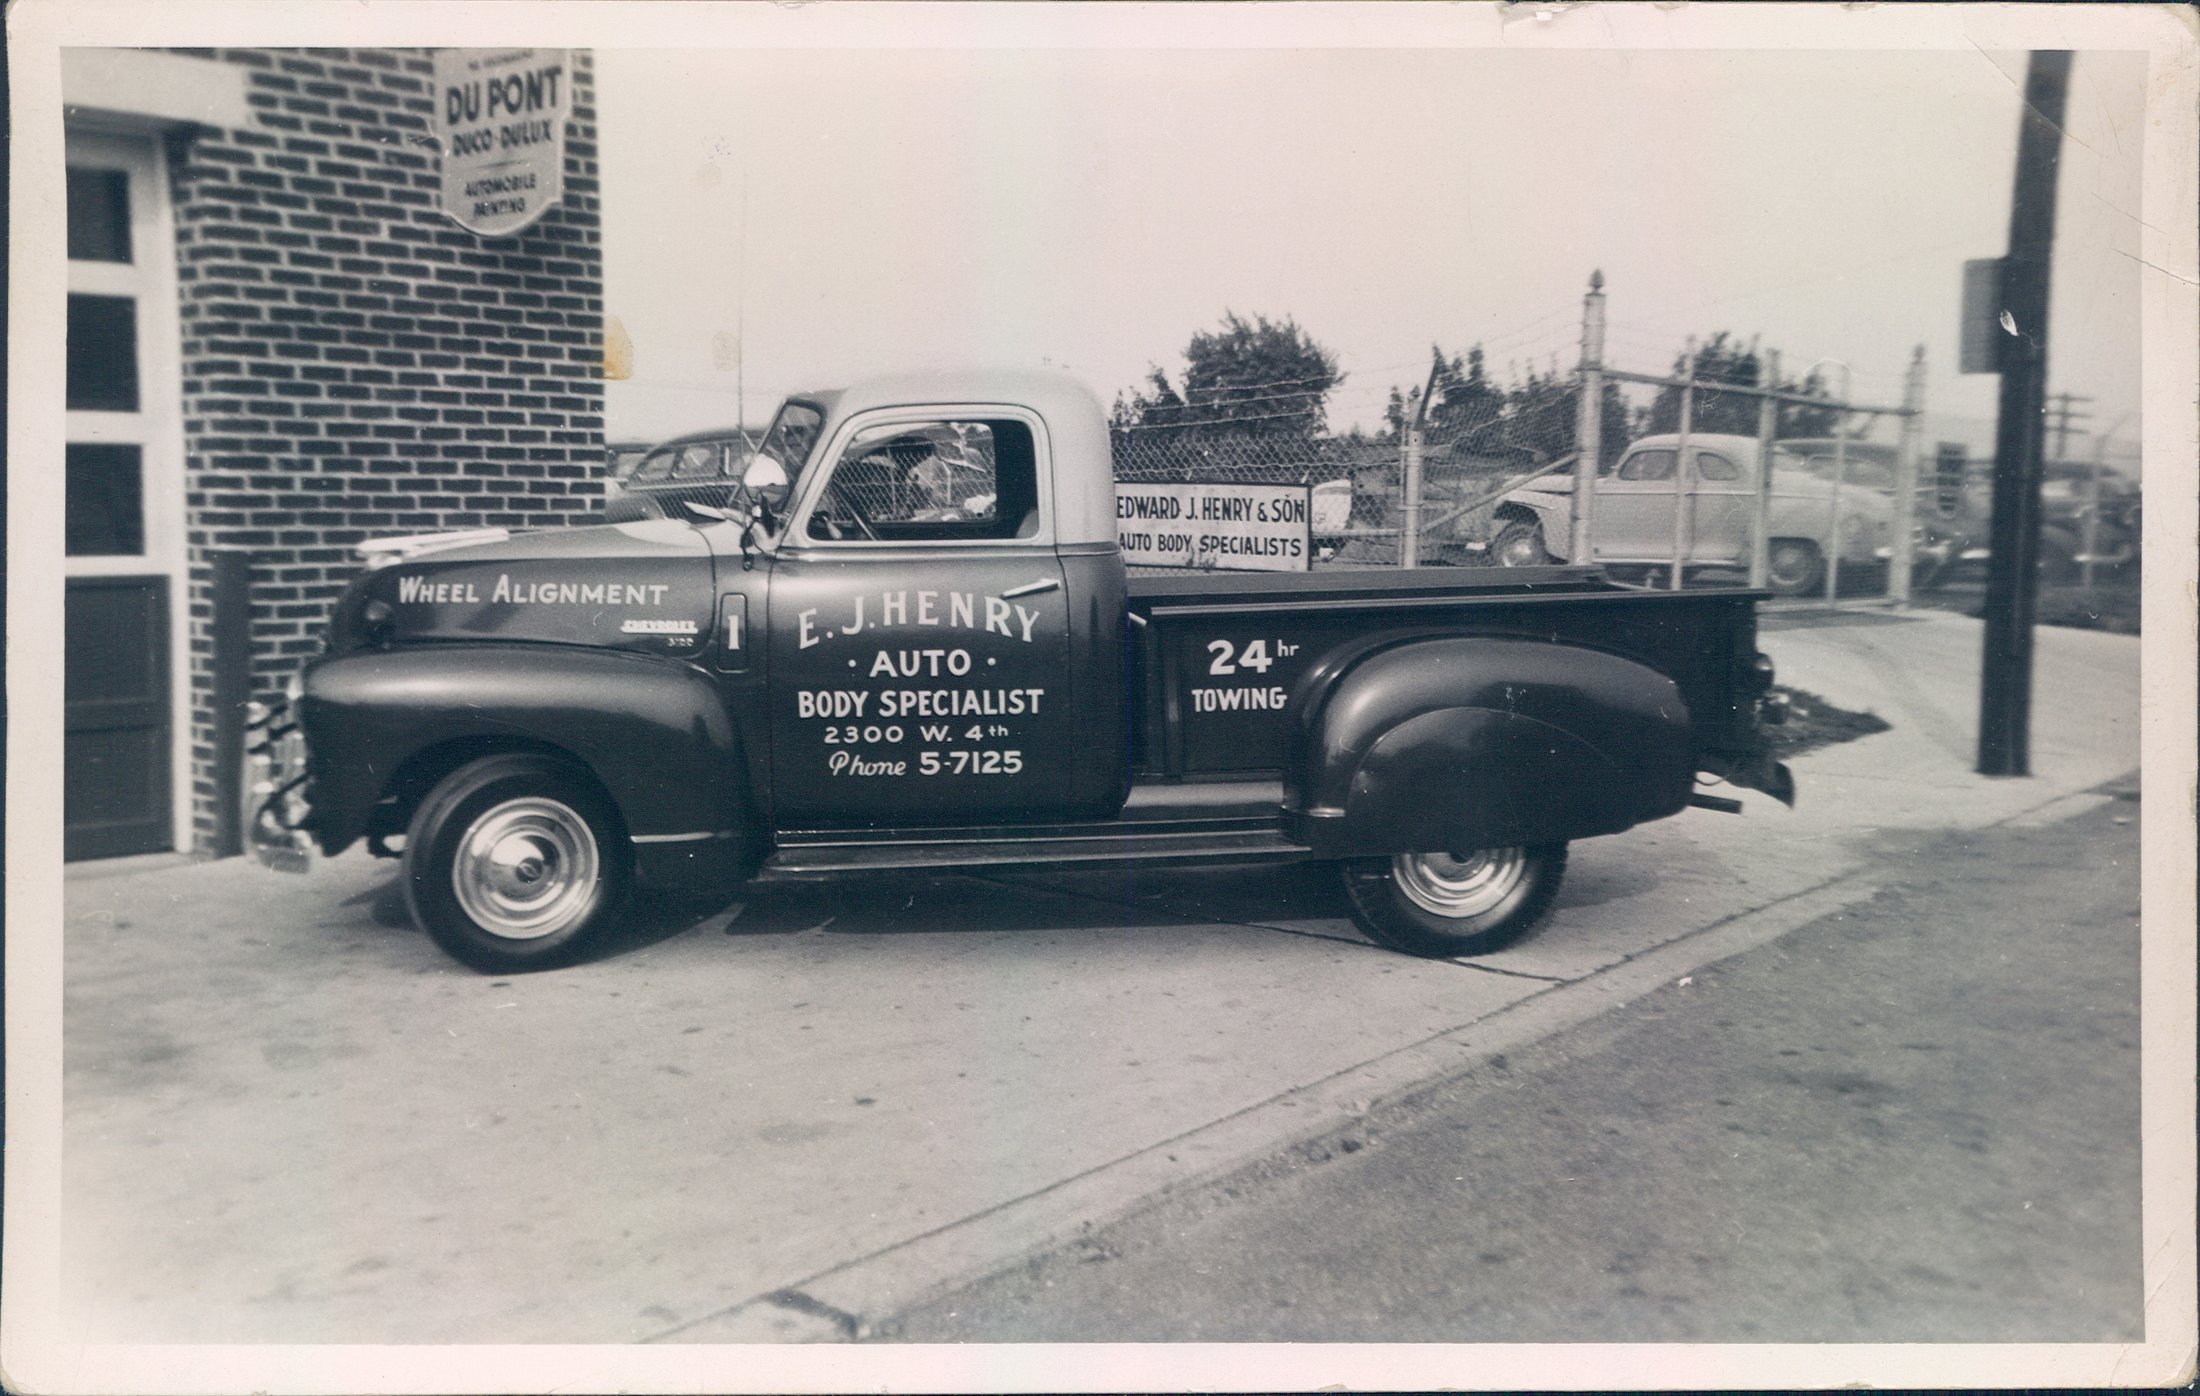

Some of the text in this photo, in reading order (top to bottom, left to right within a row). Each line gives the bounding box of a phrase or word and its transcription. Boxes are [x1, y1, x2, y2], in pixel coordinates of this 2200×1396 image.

[446, 66, 562, 125] DU PONT
[464, 172, 537, 197] AUTOMOBILE
[1116, 496, 1306, 523] EDWARD J. HENRY & SON
[1119, 532, 1302, 557] AUTO BODY SPECIALISTS
[798, 590, 1040, 650] E. J. HENRY
[869, 648, 972, 678] AUTO
[798, 688, 1045, 719] BODY SPECIALIST
[1191, 686, 1288, 713] TOWING
[823, 724, 1009, 745] 2300 W. 4th
[828, 750, 1023, 777] Phone 5-7125
